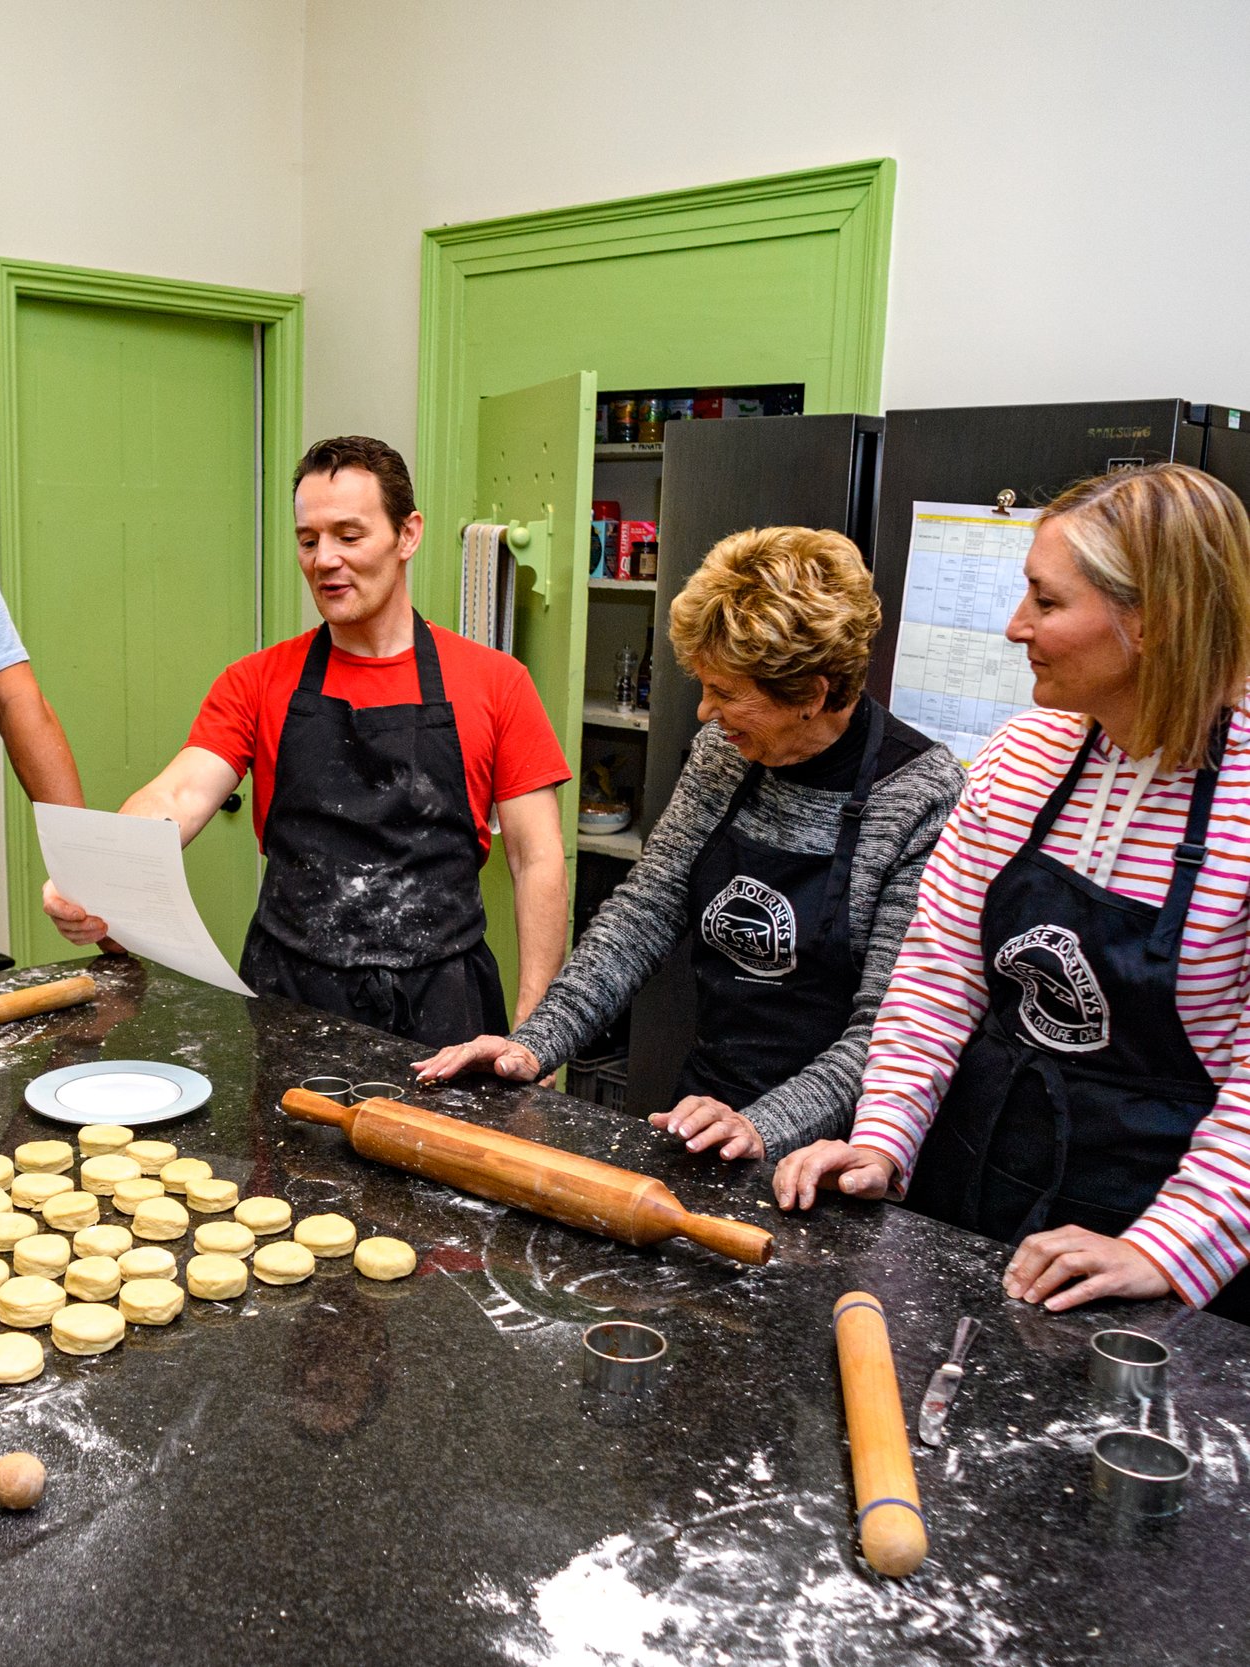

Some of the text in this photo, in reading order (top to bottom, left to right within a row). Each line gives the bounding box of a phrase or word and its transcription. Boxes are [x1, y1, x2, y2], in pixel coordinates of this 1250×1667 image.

[706, 882, 791, 941] CHEESE JOURNEYS
[997, 931, 1102, 1015] CHEESE JOURNEYS
[1033, 1015, 1075, 1043] CULTURE.
